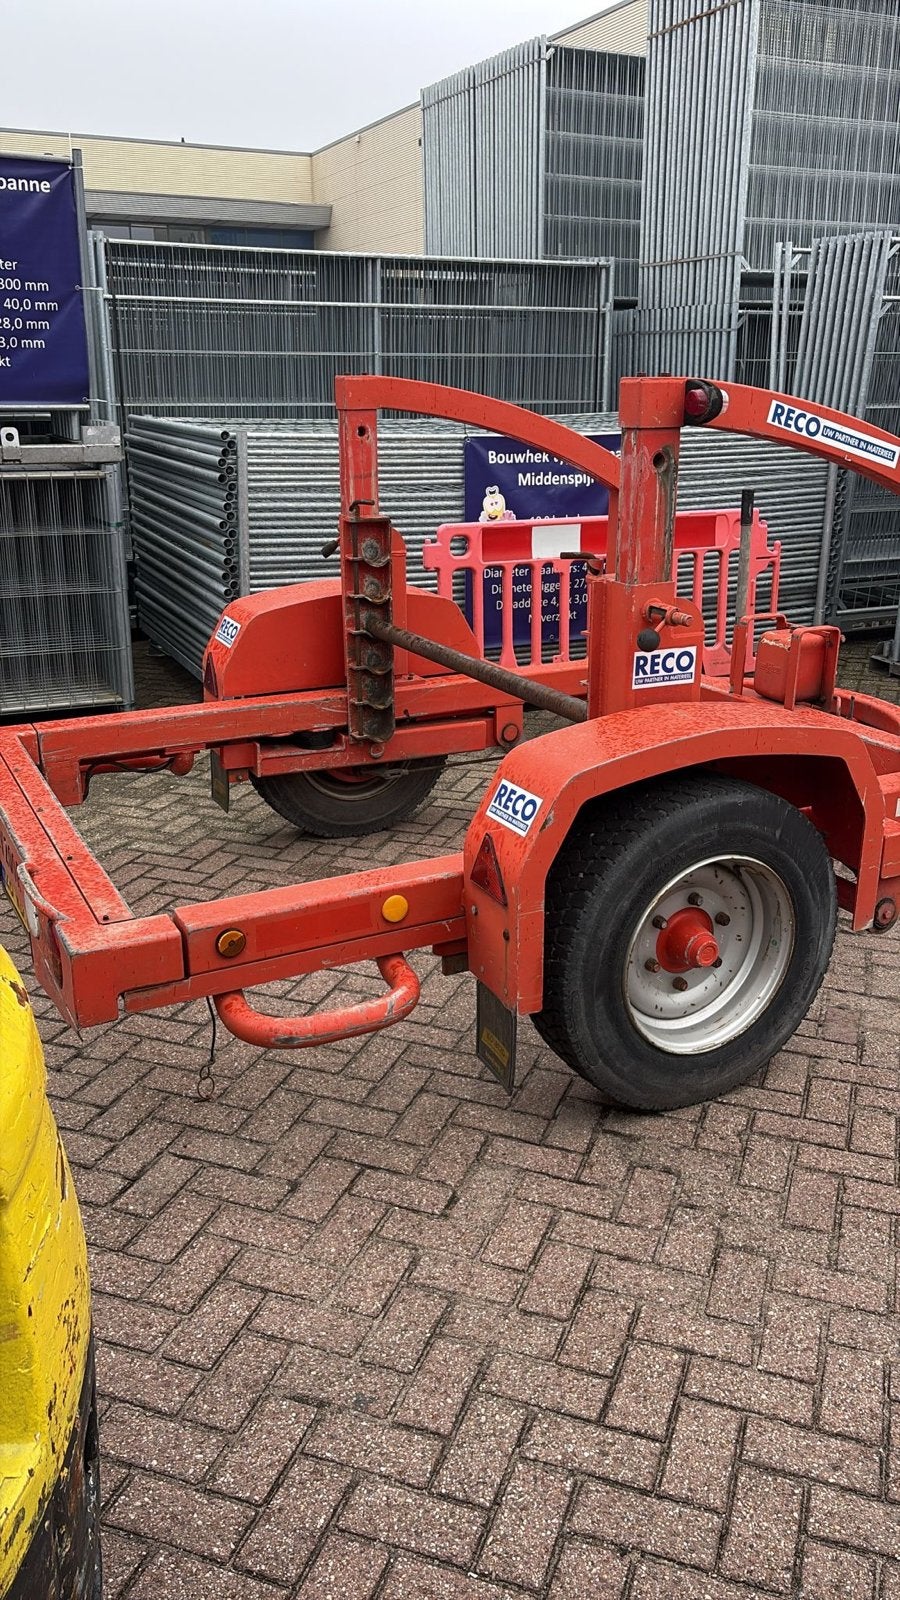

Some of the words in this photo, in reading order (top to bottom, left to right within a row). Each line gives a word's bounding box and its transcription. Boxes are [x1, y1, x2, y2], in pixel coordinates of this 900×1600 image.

[24, 281, 49, 292] mm
[3, 298, 31, 312] 40,0
[34, 301, 59, 311] mm
[26, 320, 50, 330] mm
[21, 339, 46, 349] mm
[771, 403, 821, 437] RECO
[834, 431, 860, 448] PARTNER
[859, 441, 867, 450] IN
[866, 443, 895, 460] MATERIEEL
[488, 449, 549, 464] Bouwhek
[483, 567, 530, 579] Diater
[635, 650, 695, 677] RECO
[493, 783, 538, 822] RECO
